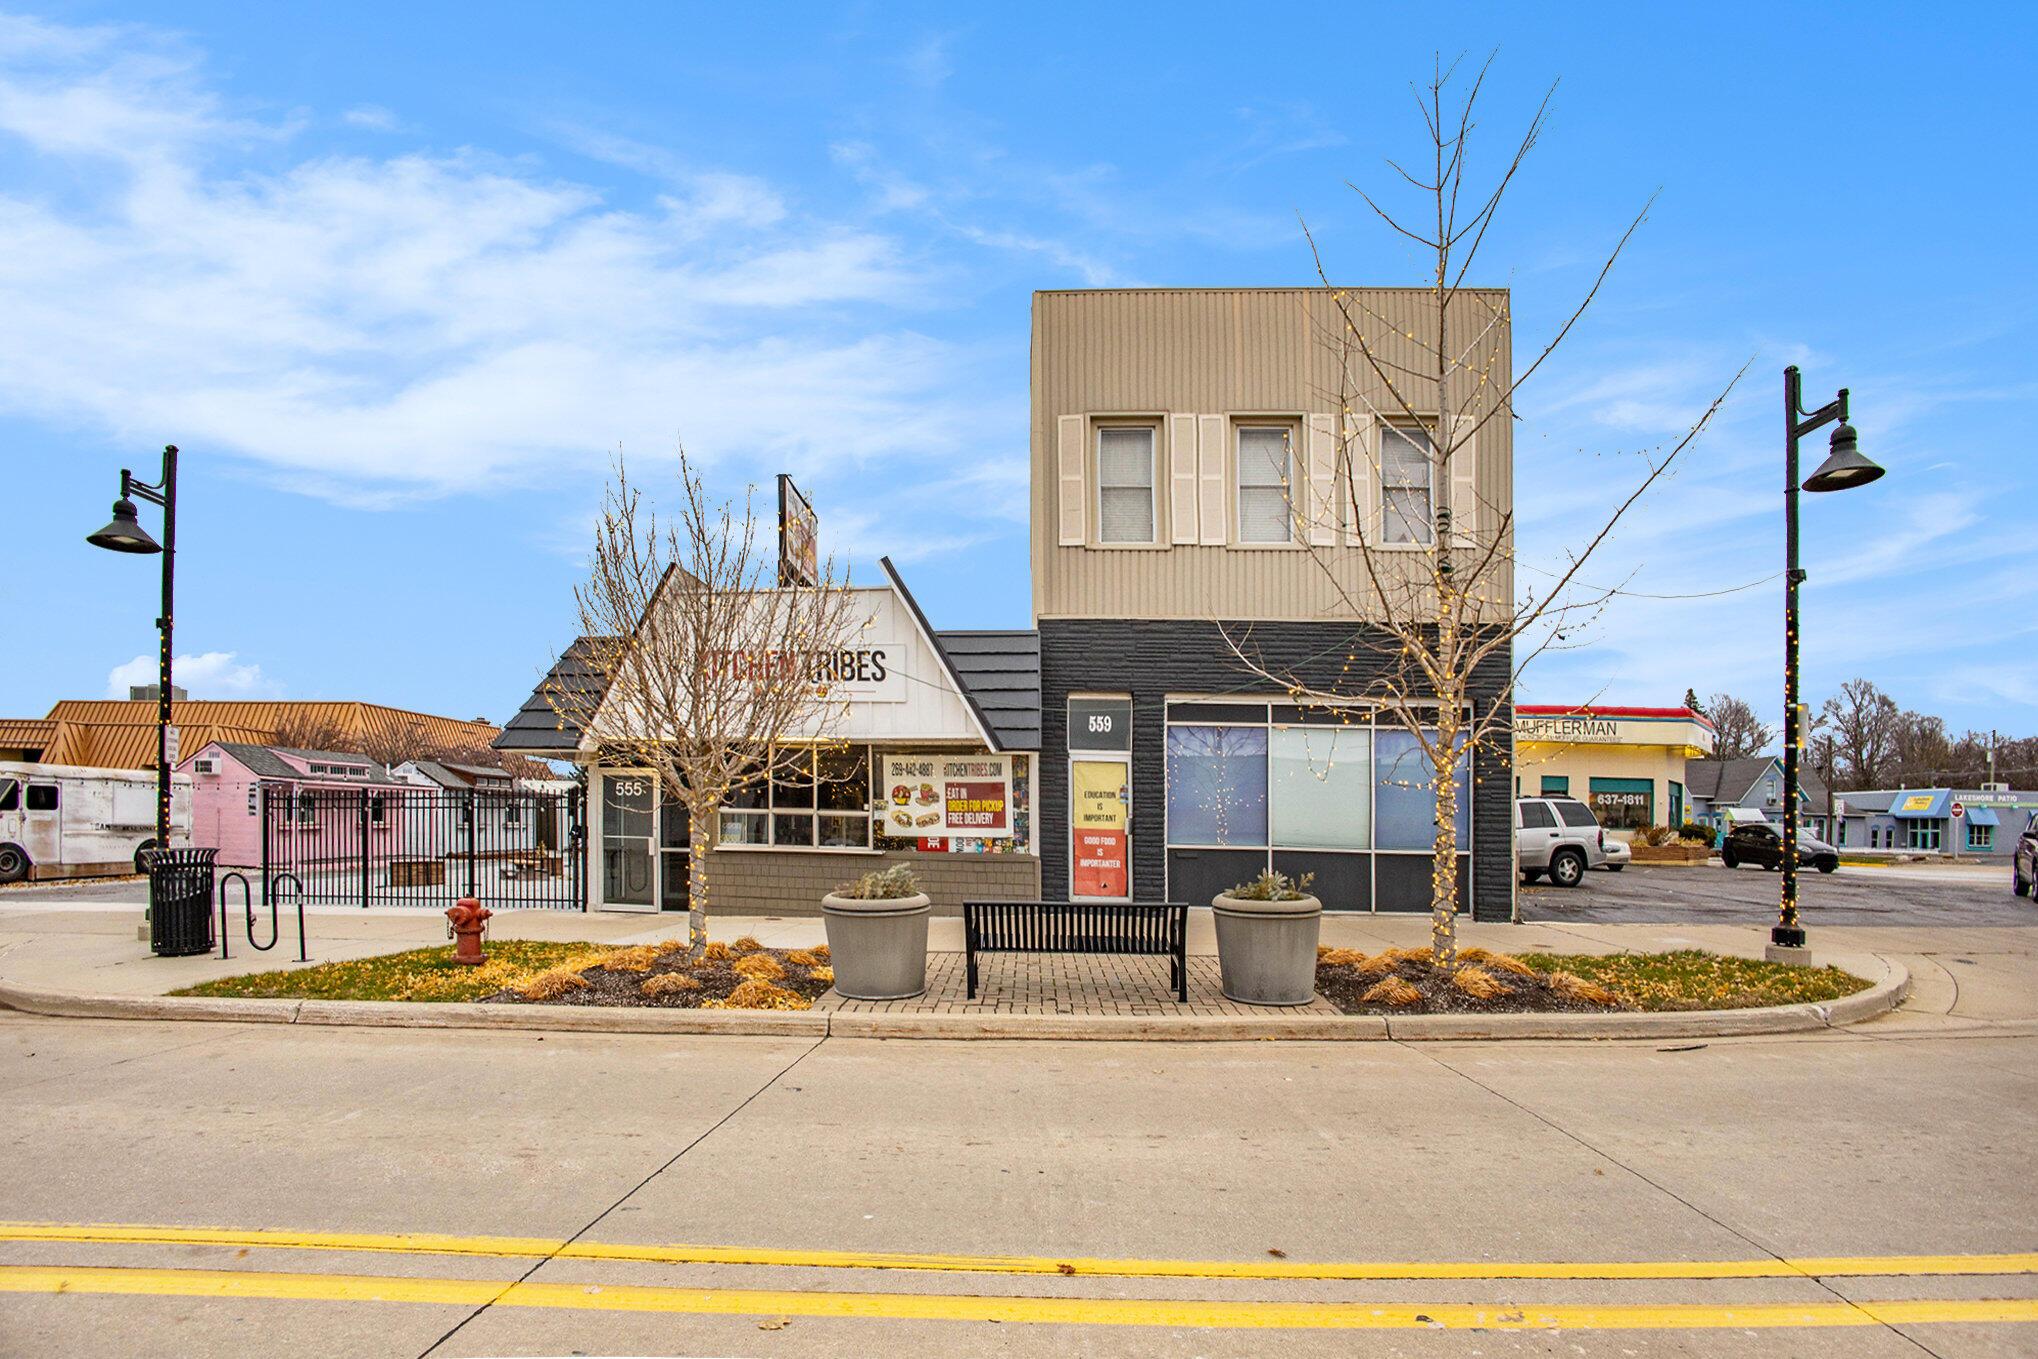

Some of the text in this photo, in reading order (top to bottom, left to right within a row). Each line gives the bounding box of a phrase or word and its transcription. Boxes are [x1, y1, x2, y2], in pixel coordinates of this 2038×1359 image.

[1089, 715, 1112, 733] 559
[615, 782, 643, 796] 555
[947, 787, 959, 799] EAT
[1084, 791, 1116, 799] EDUCATION
[1597, 794, 1644, 805] 637-1811
[1955, 794, 2018, 803] LAKESHORE PATIO
[947, 800, 1004, 812] ORDER FOR PICKUP
[1097, 803, 1103, 811] IS
[948, 812, 993, 825] FREE DELIVERY
[1083, 814, 1116, 822] IMPORTANT
[1084, 836, 1117, 846] GOOD FOOD
[1097, 848, 1104, 856] IS
